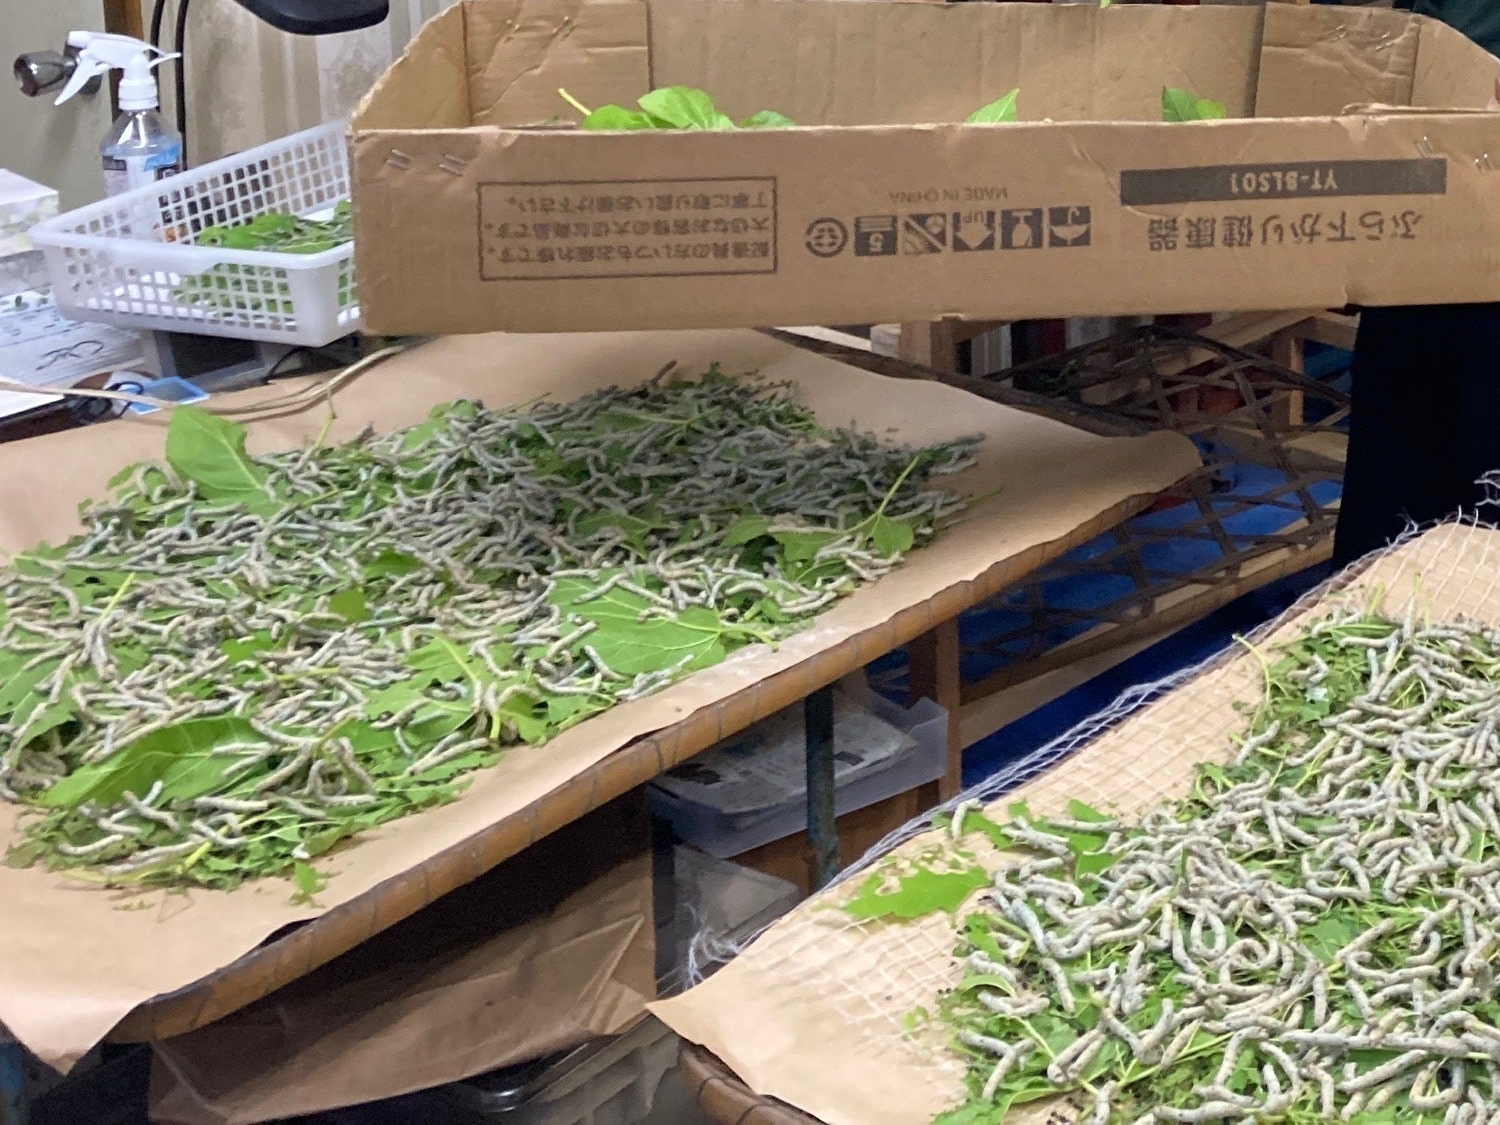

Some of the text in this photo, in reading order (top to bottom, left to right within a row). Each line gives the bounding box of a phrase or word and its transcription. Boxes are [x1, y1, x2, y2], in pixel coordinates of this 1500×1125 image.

[1231, 169, 1338, 193] YT-BLS01
[888, 185, 1009, 204] MADE IN CHINA
[1148, 210, 1423, 252] ぶら下がり健康器
